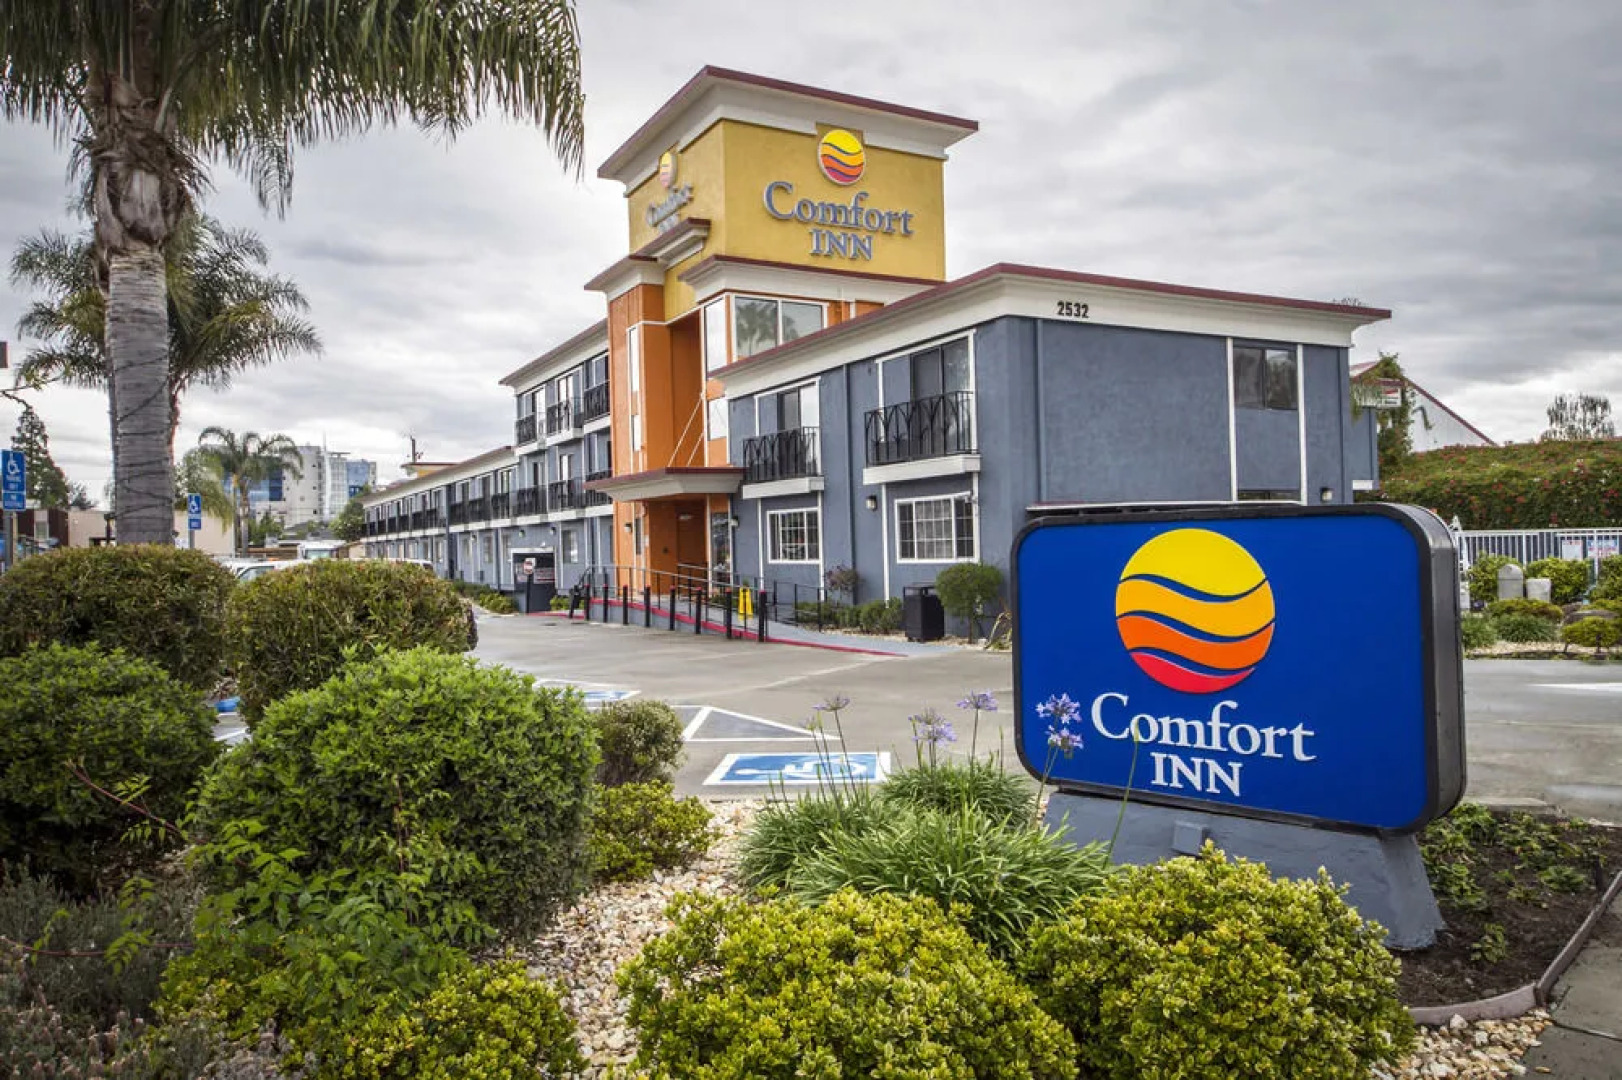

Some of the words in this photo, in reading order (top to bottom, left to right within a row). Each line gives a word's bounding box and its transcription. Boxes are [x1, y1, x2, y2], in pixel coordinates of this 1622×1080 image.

[764, 181, 914, 235] Comfort
[809, 229, 873, 260] INN
[1057, 300, 1090, 318] 2532
[1091, 692, 1317, 761] Comfort
[1150, 752, 1243, 797] INN
